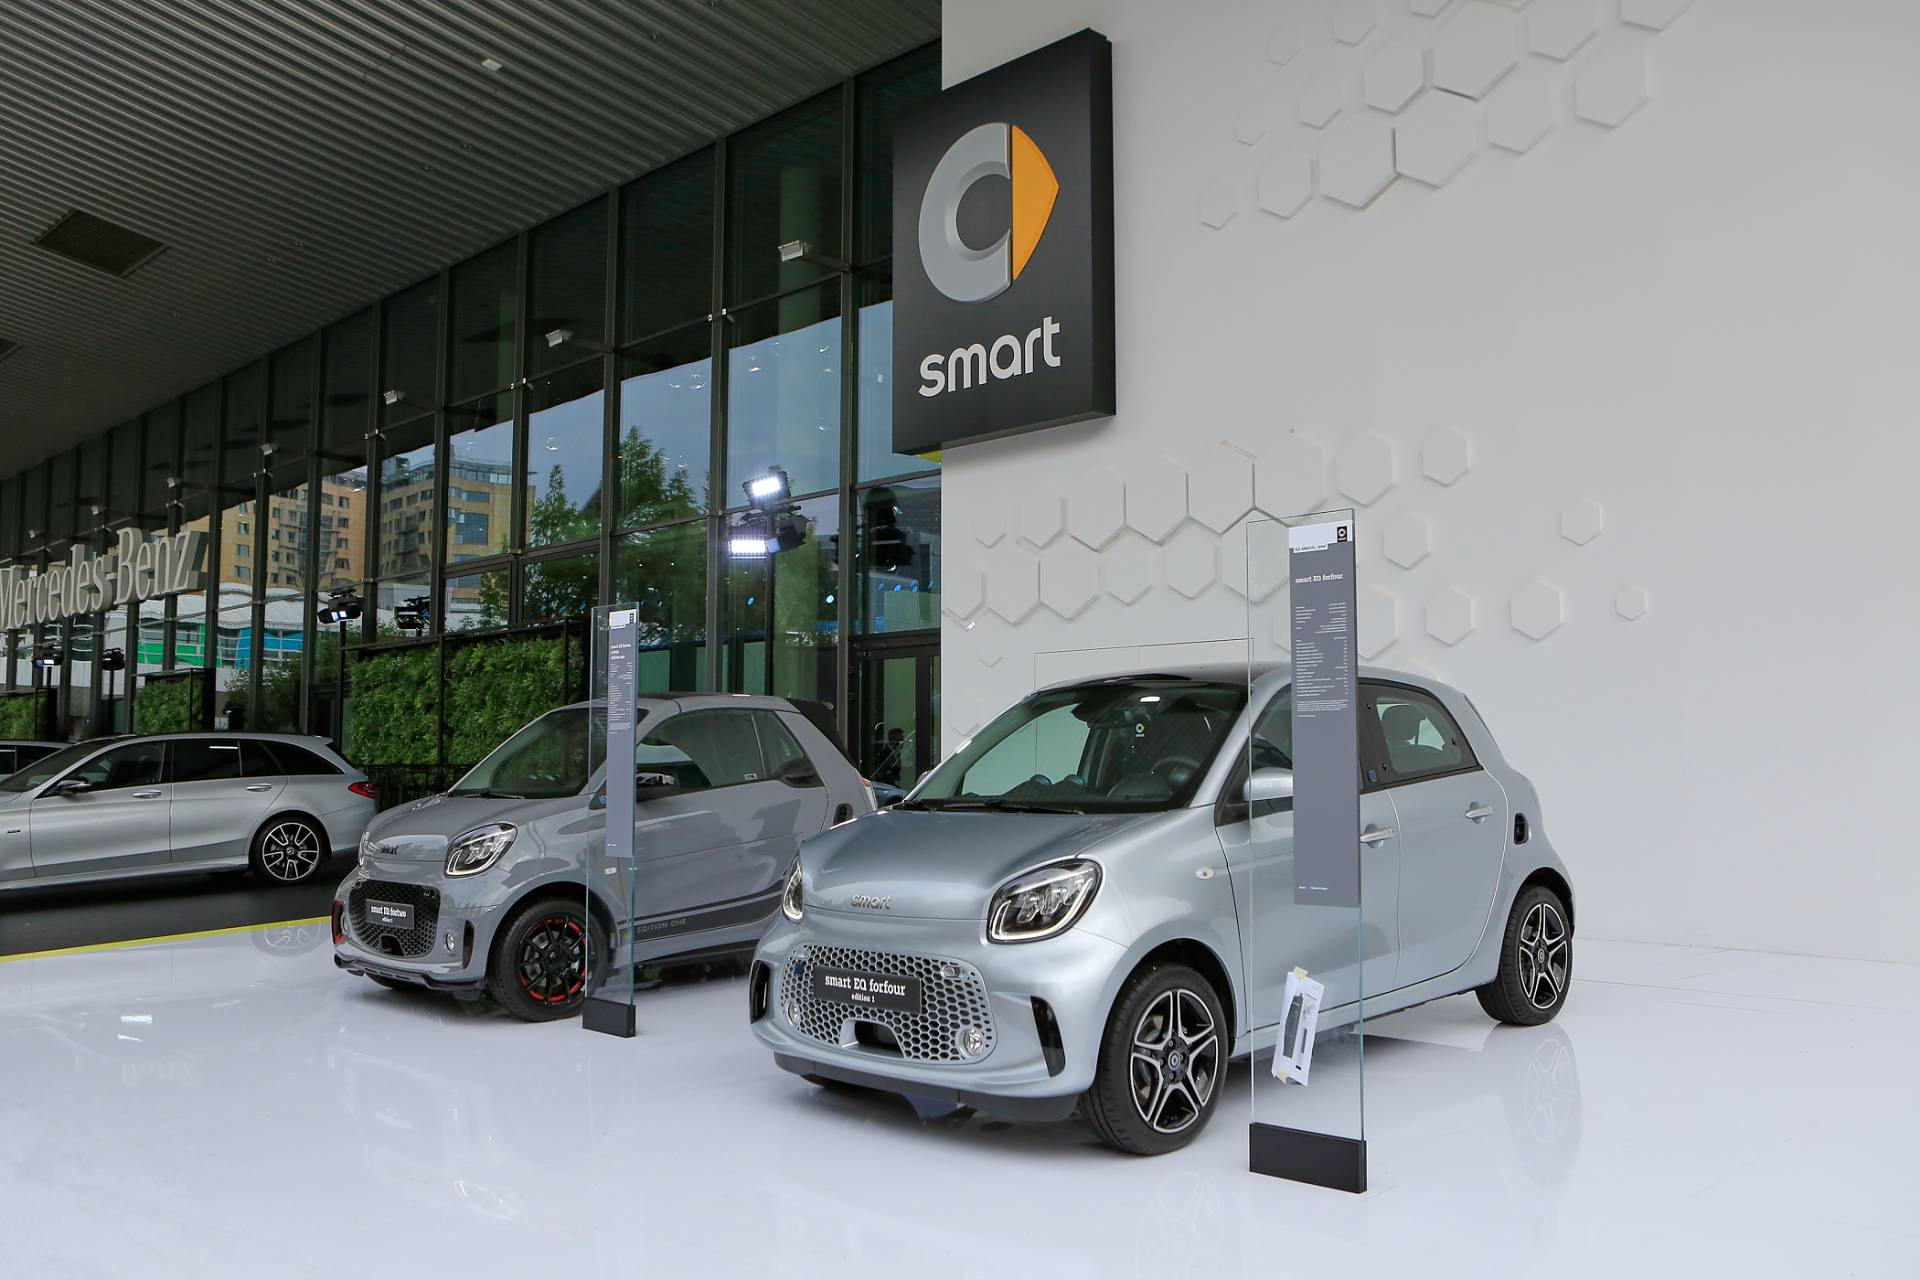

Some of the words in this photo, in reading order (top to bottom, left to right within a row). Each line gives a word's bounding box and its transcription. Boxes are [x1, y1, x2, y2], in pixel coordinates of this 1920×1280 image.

[918, 316, 1061, 397] smart
[0, 527, 200, 630] Mercedes-Benz
[370, 906, 383, 914] smart
[851, 894, 893, 910] smart
[637, 922, 668, 934] EDITION
[670, 919, 687, 927] ONE
[825, 975, 852, 989] smart
[853, 977, 868, 991] EQ
[869, 979, 906, 996] forfour
[851, 993, 871, 1002] edition
